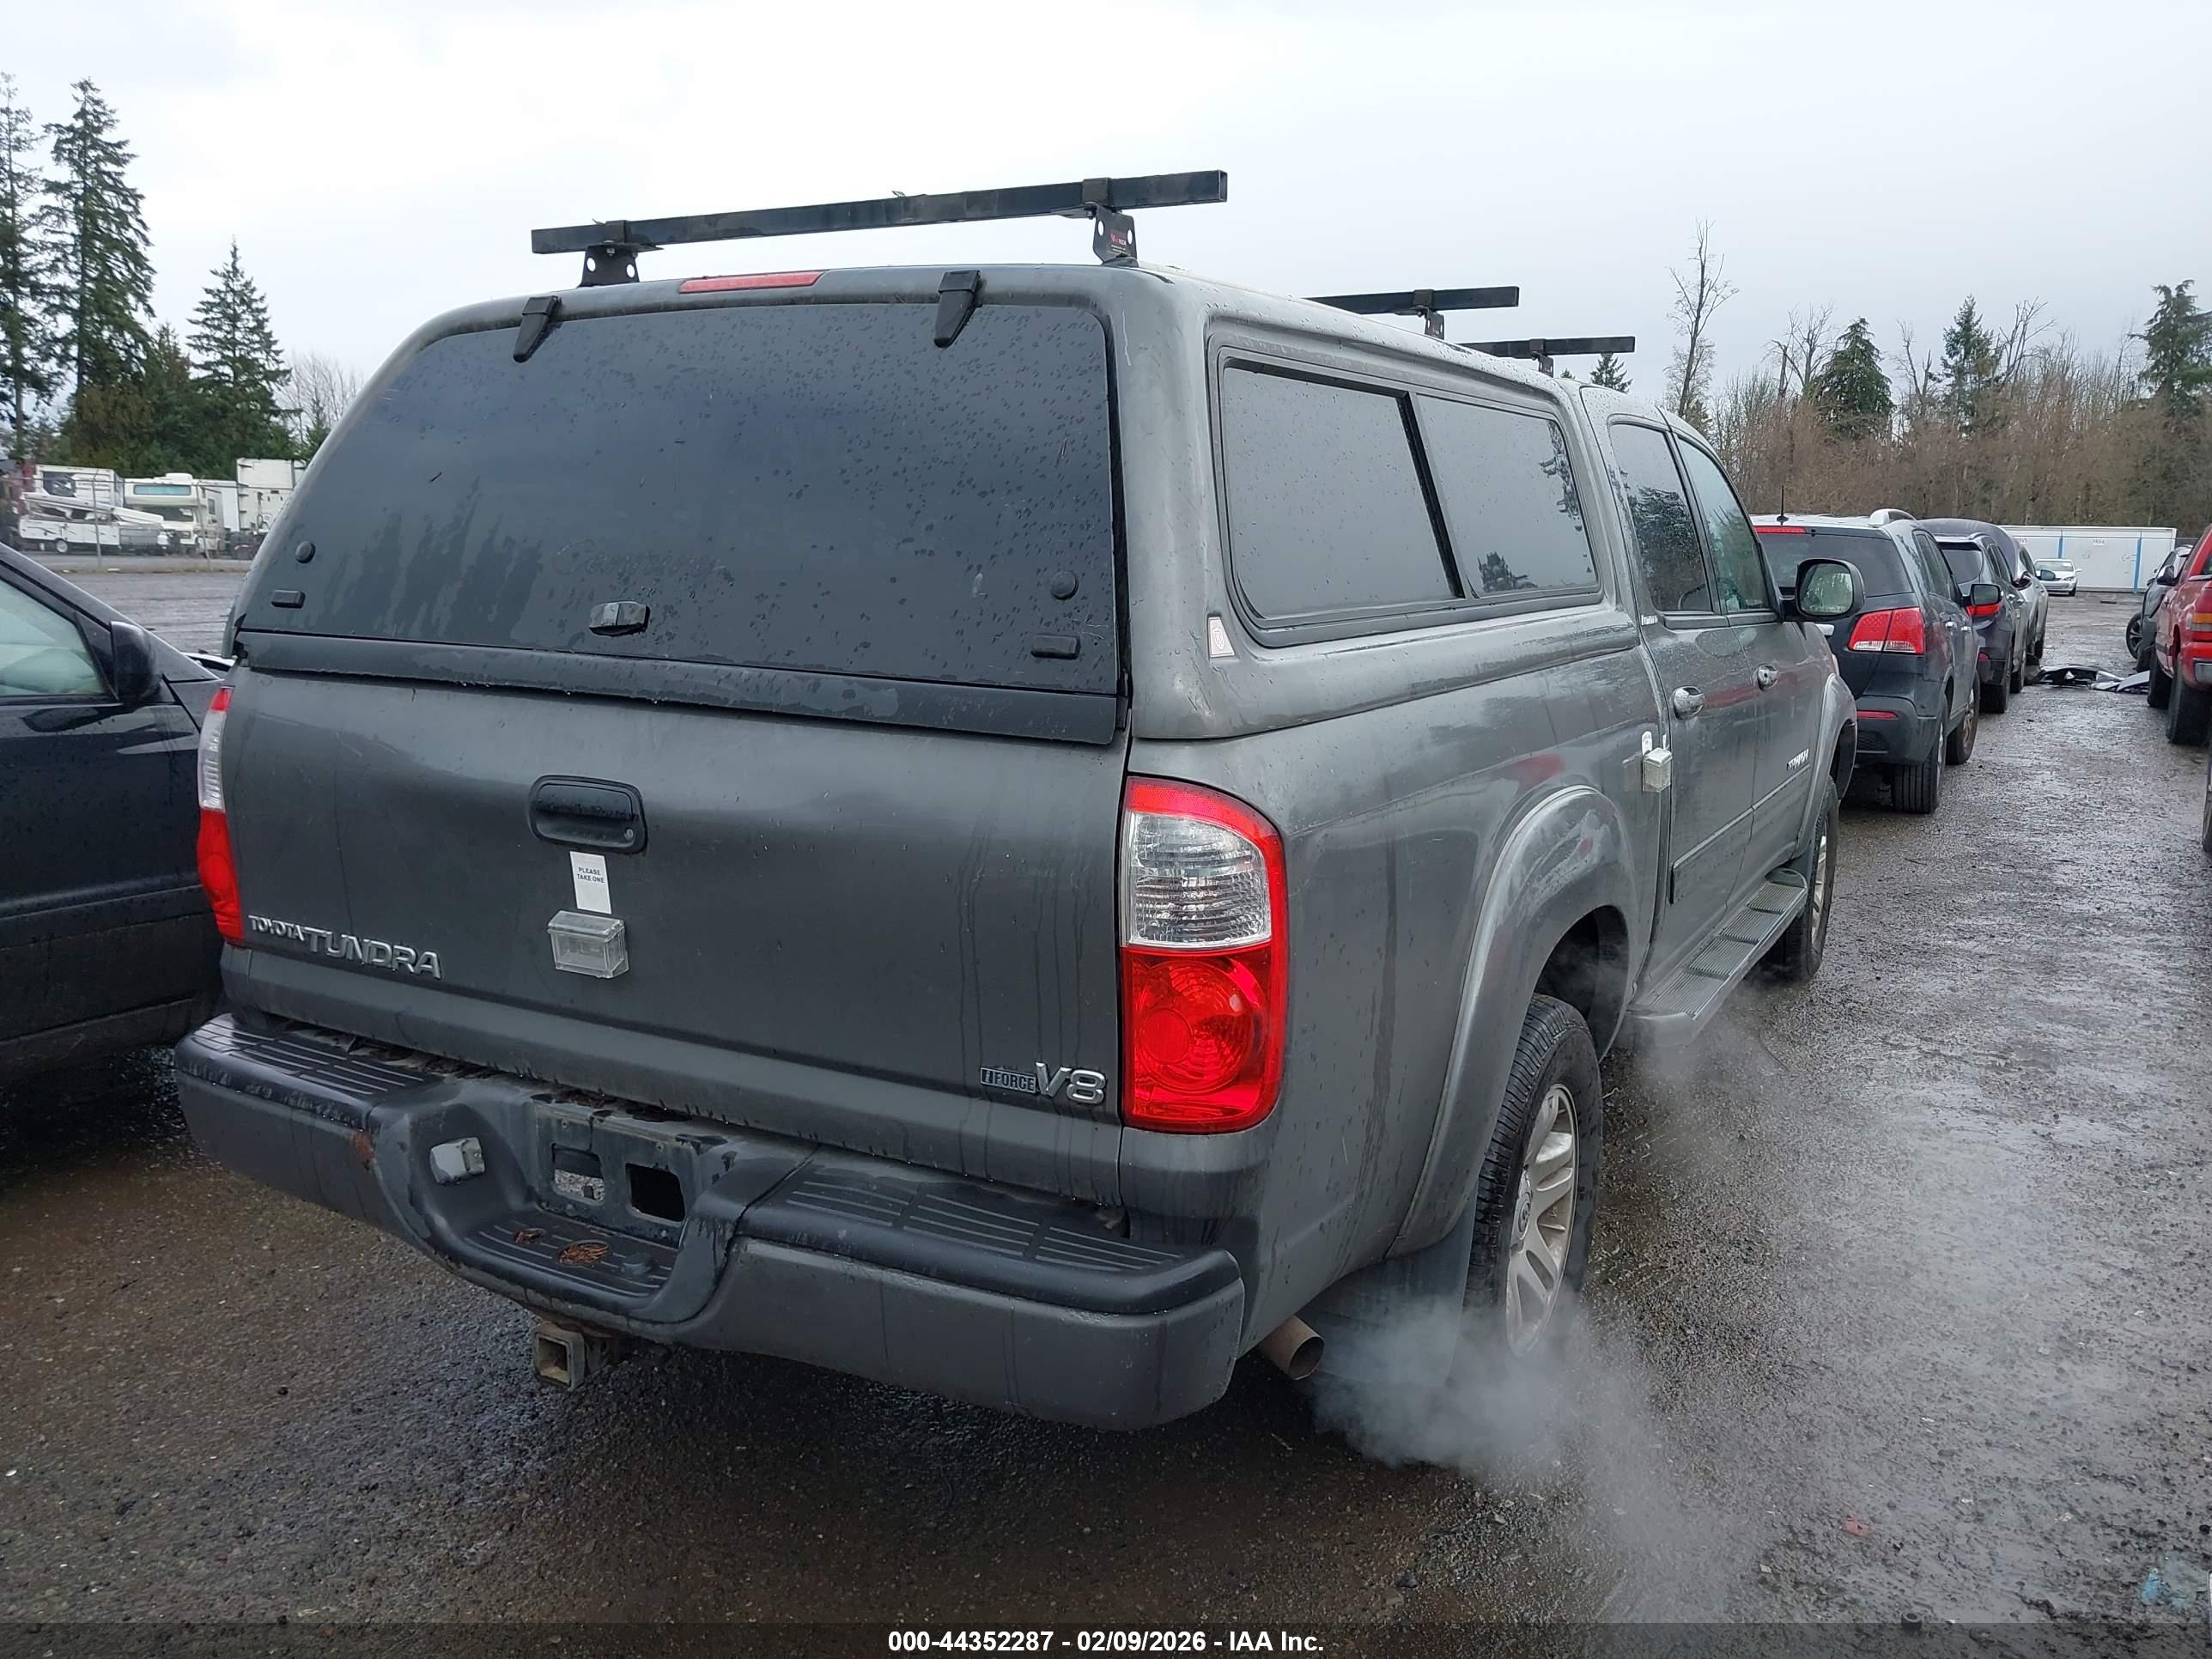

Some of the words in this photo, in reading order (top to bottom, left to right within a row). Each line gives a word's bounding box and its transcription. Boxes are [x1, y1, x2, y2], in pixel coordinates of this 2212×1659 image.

[578, 866, 601, 876] PLEASE
[248, 915, 306, 942] TOYOTA
[304, 926, 442, 980] TUNDRA
[1036, 1062, 1106, 1105] V8
